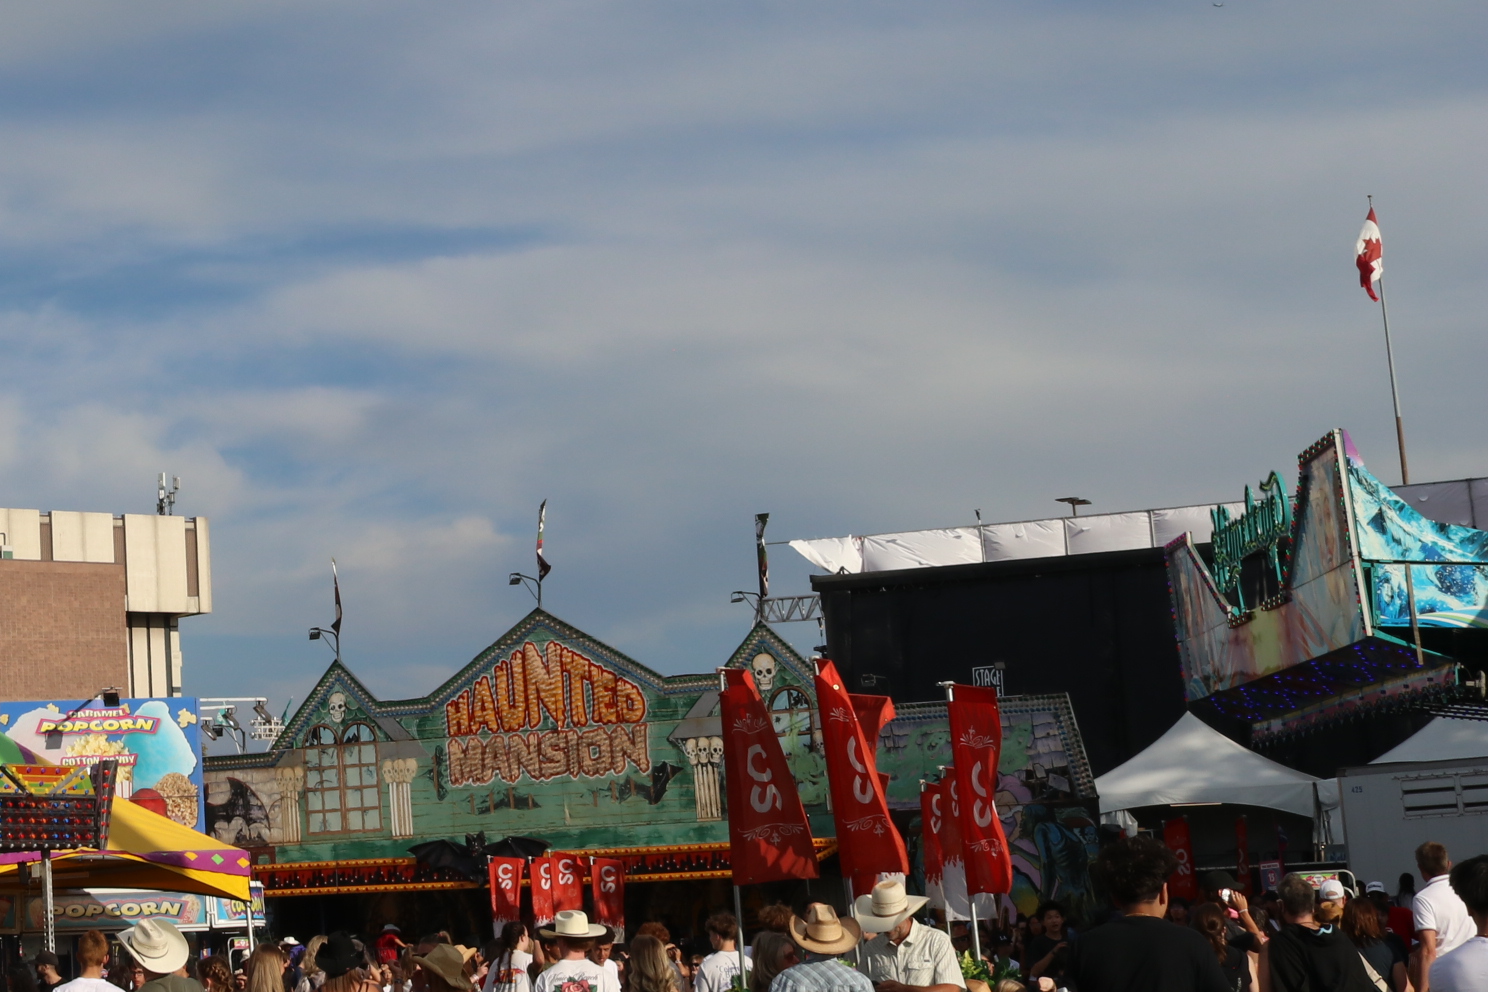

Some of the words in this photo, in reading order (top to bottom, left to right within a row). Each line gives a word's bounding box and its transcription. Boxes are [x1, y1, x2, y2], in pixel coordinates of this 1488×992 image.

[976, 669, 1000, 687] STAGE
[446, 641, 647, 737] HAUNTED
[68, 708, 125, 718] CARAMEL
[40, 719, 154, 732] POPCORN
[62, 756, 100, 766] COTTON
[447, 723, 650, 786] MANSION
[53, 901, 182, 918] POPCORN
